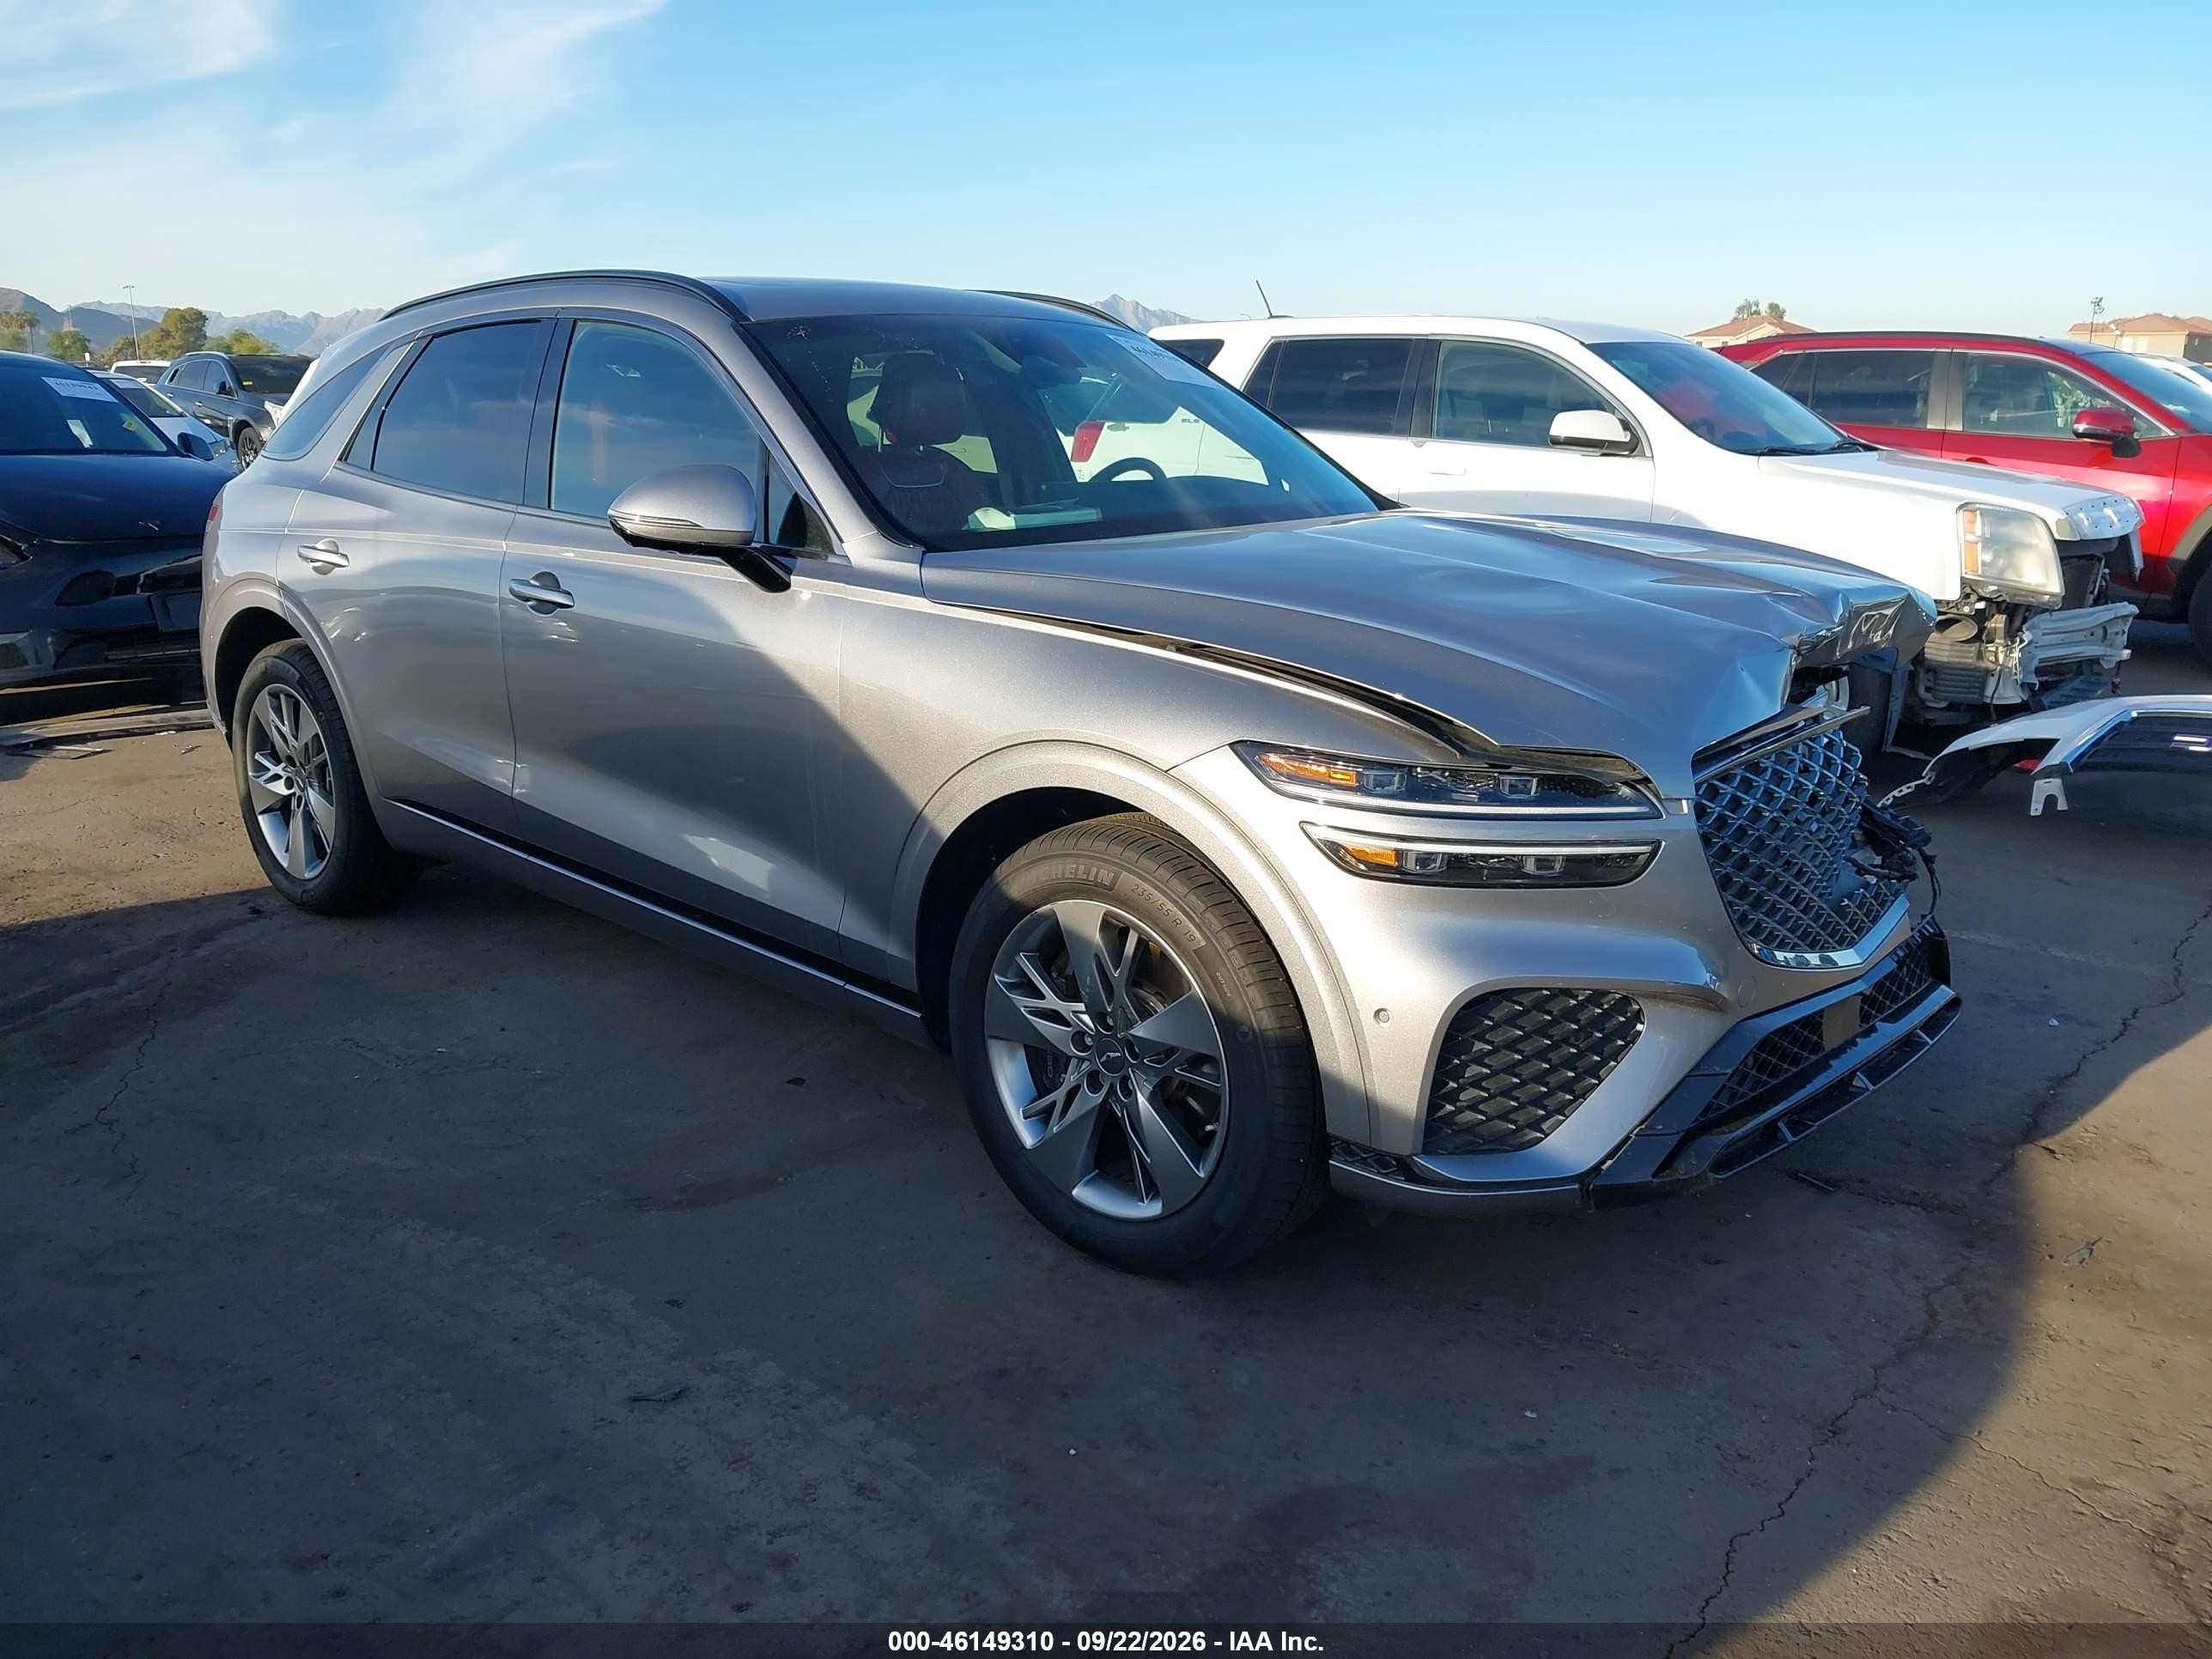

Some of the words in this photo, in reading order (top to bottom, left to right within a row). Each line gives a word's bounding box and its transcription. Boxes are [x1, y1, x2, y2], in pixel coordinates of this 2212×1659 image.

[1131, 884, 1172, 916] 235/55
[1171, 917, 1182, 927] R
[1182, 929, 1196, 942] 19
